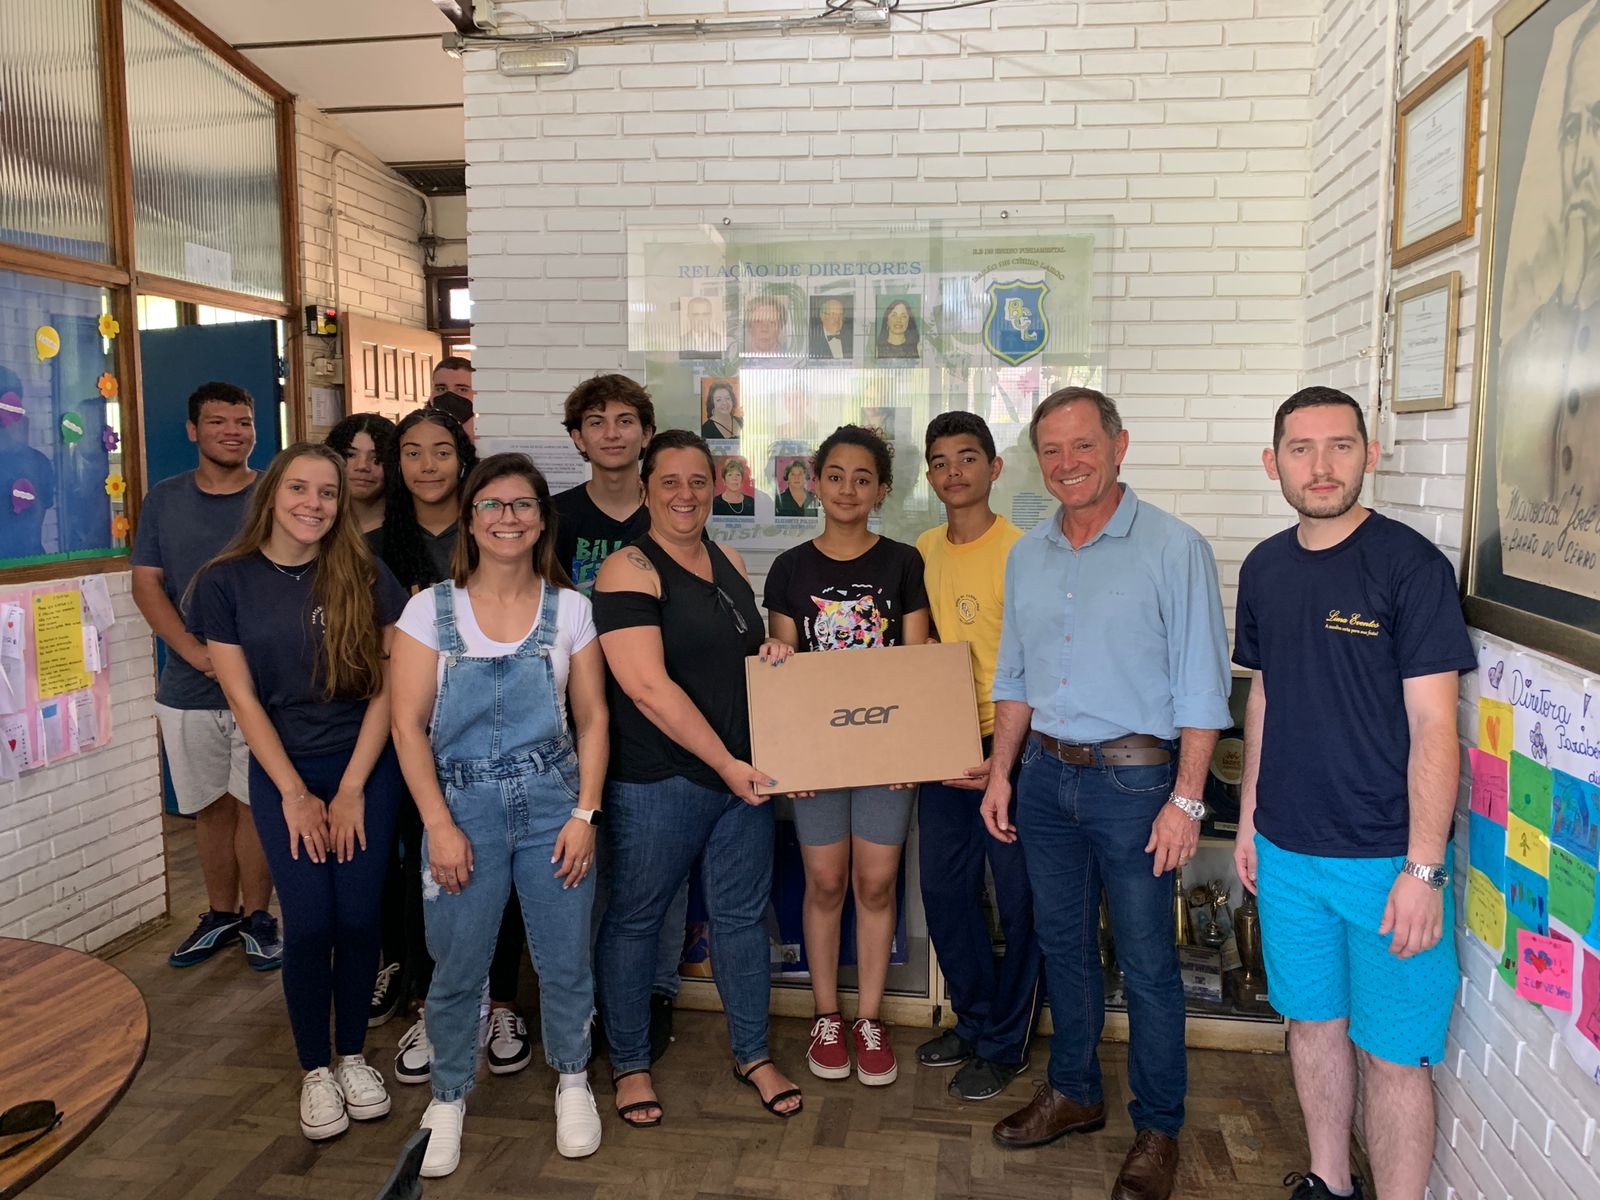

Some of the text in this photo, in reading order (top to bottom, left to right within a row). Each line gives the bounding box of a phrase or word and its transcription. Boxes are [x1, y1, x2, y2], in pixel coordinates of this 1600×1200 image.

[679, 261, 922, 281] RELAÇÃO DE DIRETORES
[1541, 541, 1555, 559] DO
[1508, 669, 1571, 725] Diretora
[830, 705, 899, 727] acer
